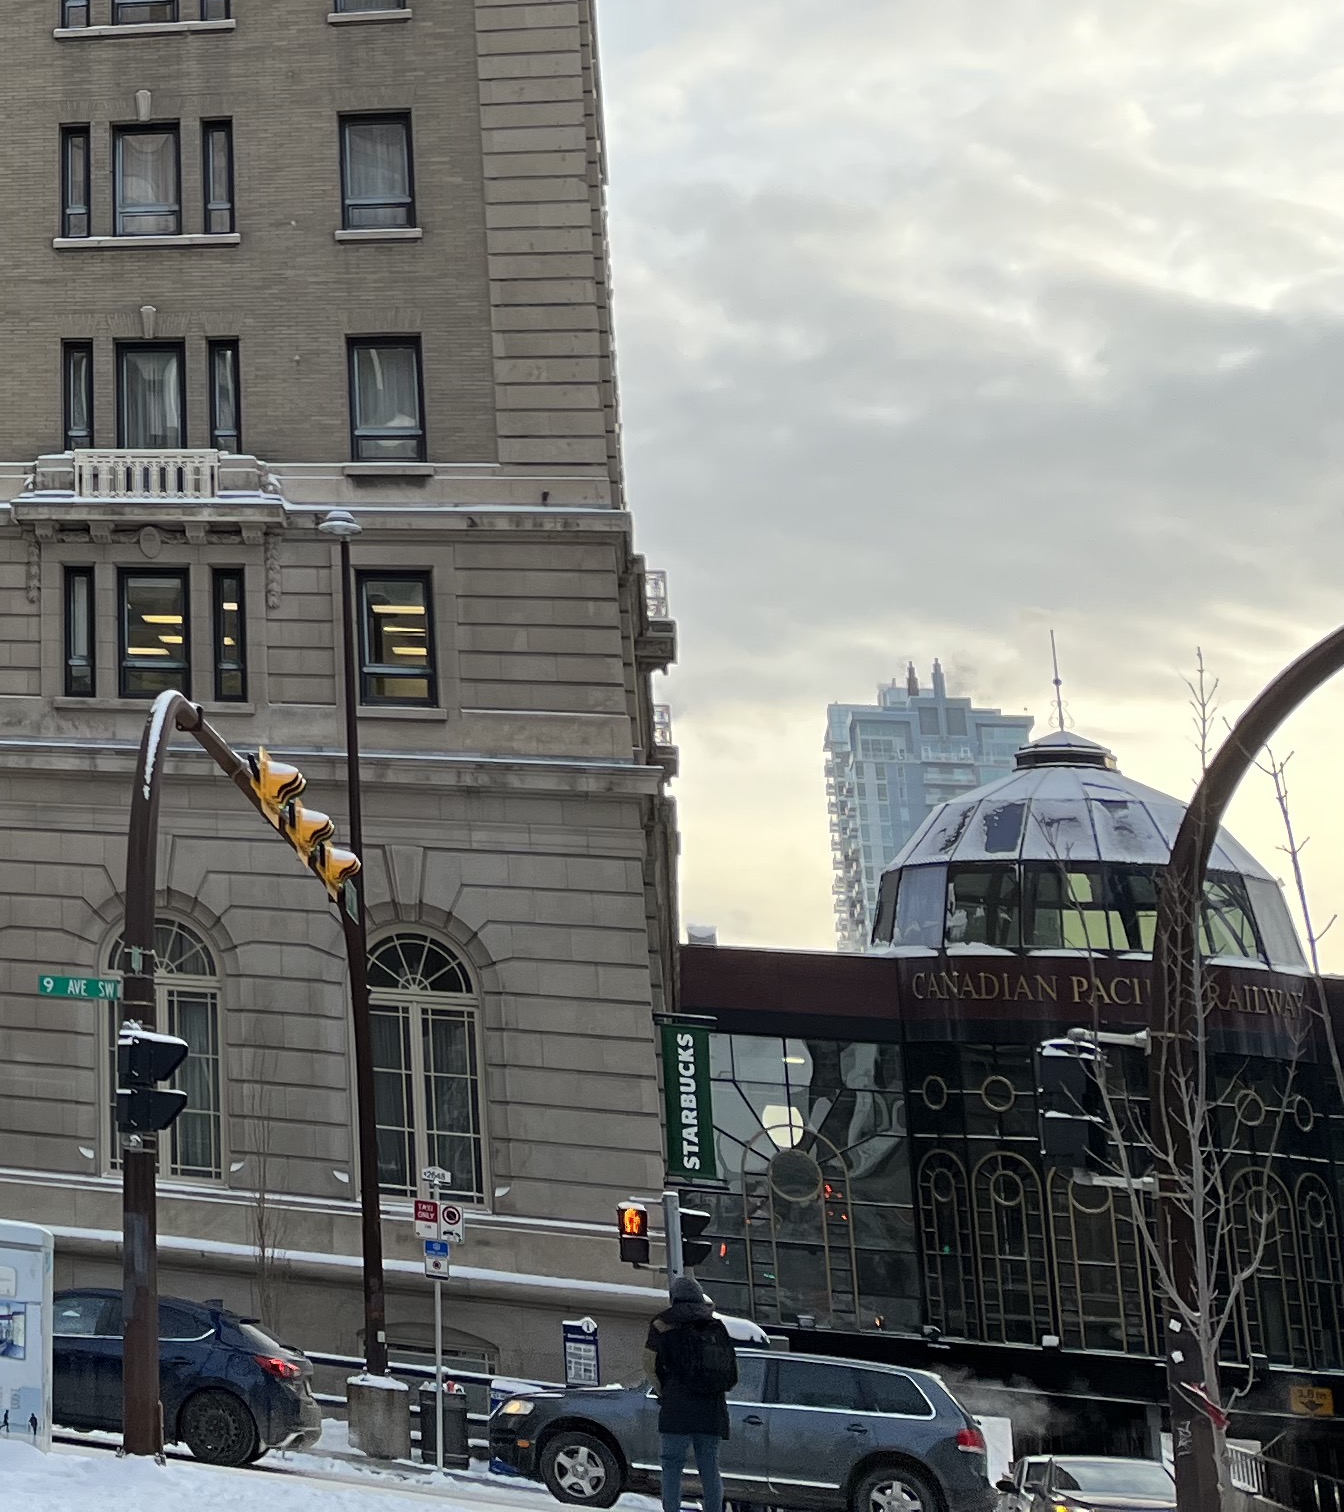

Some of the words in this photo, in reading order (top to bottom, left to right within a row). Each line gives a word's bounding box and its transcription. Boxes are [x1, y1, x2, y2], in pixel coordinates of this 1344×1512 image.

[43, 977, 54, 993] 9
[67, 979, 88, 996] AVE
[98, 981, 115, 998] SW
[912, 971, 1059, 1002] CANADIAN
[1070, 975, 1151, 1006] PACI
[676, 1033, 701, 1170] STARBUCKS
